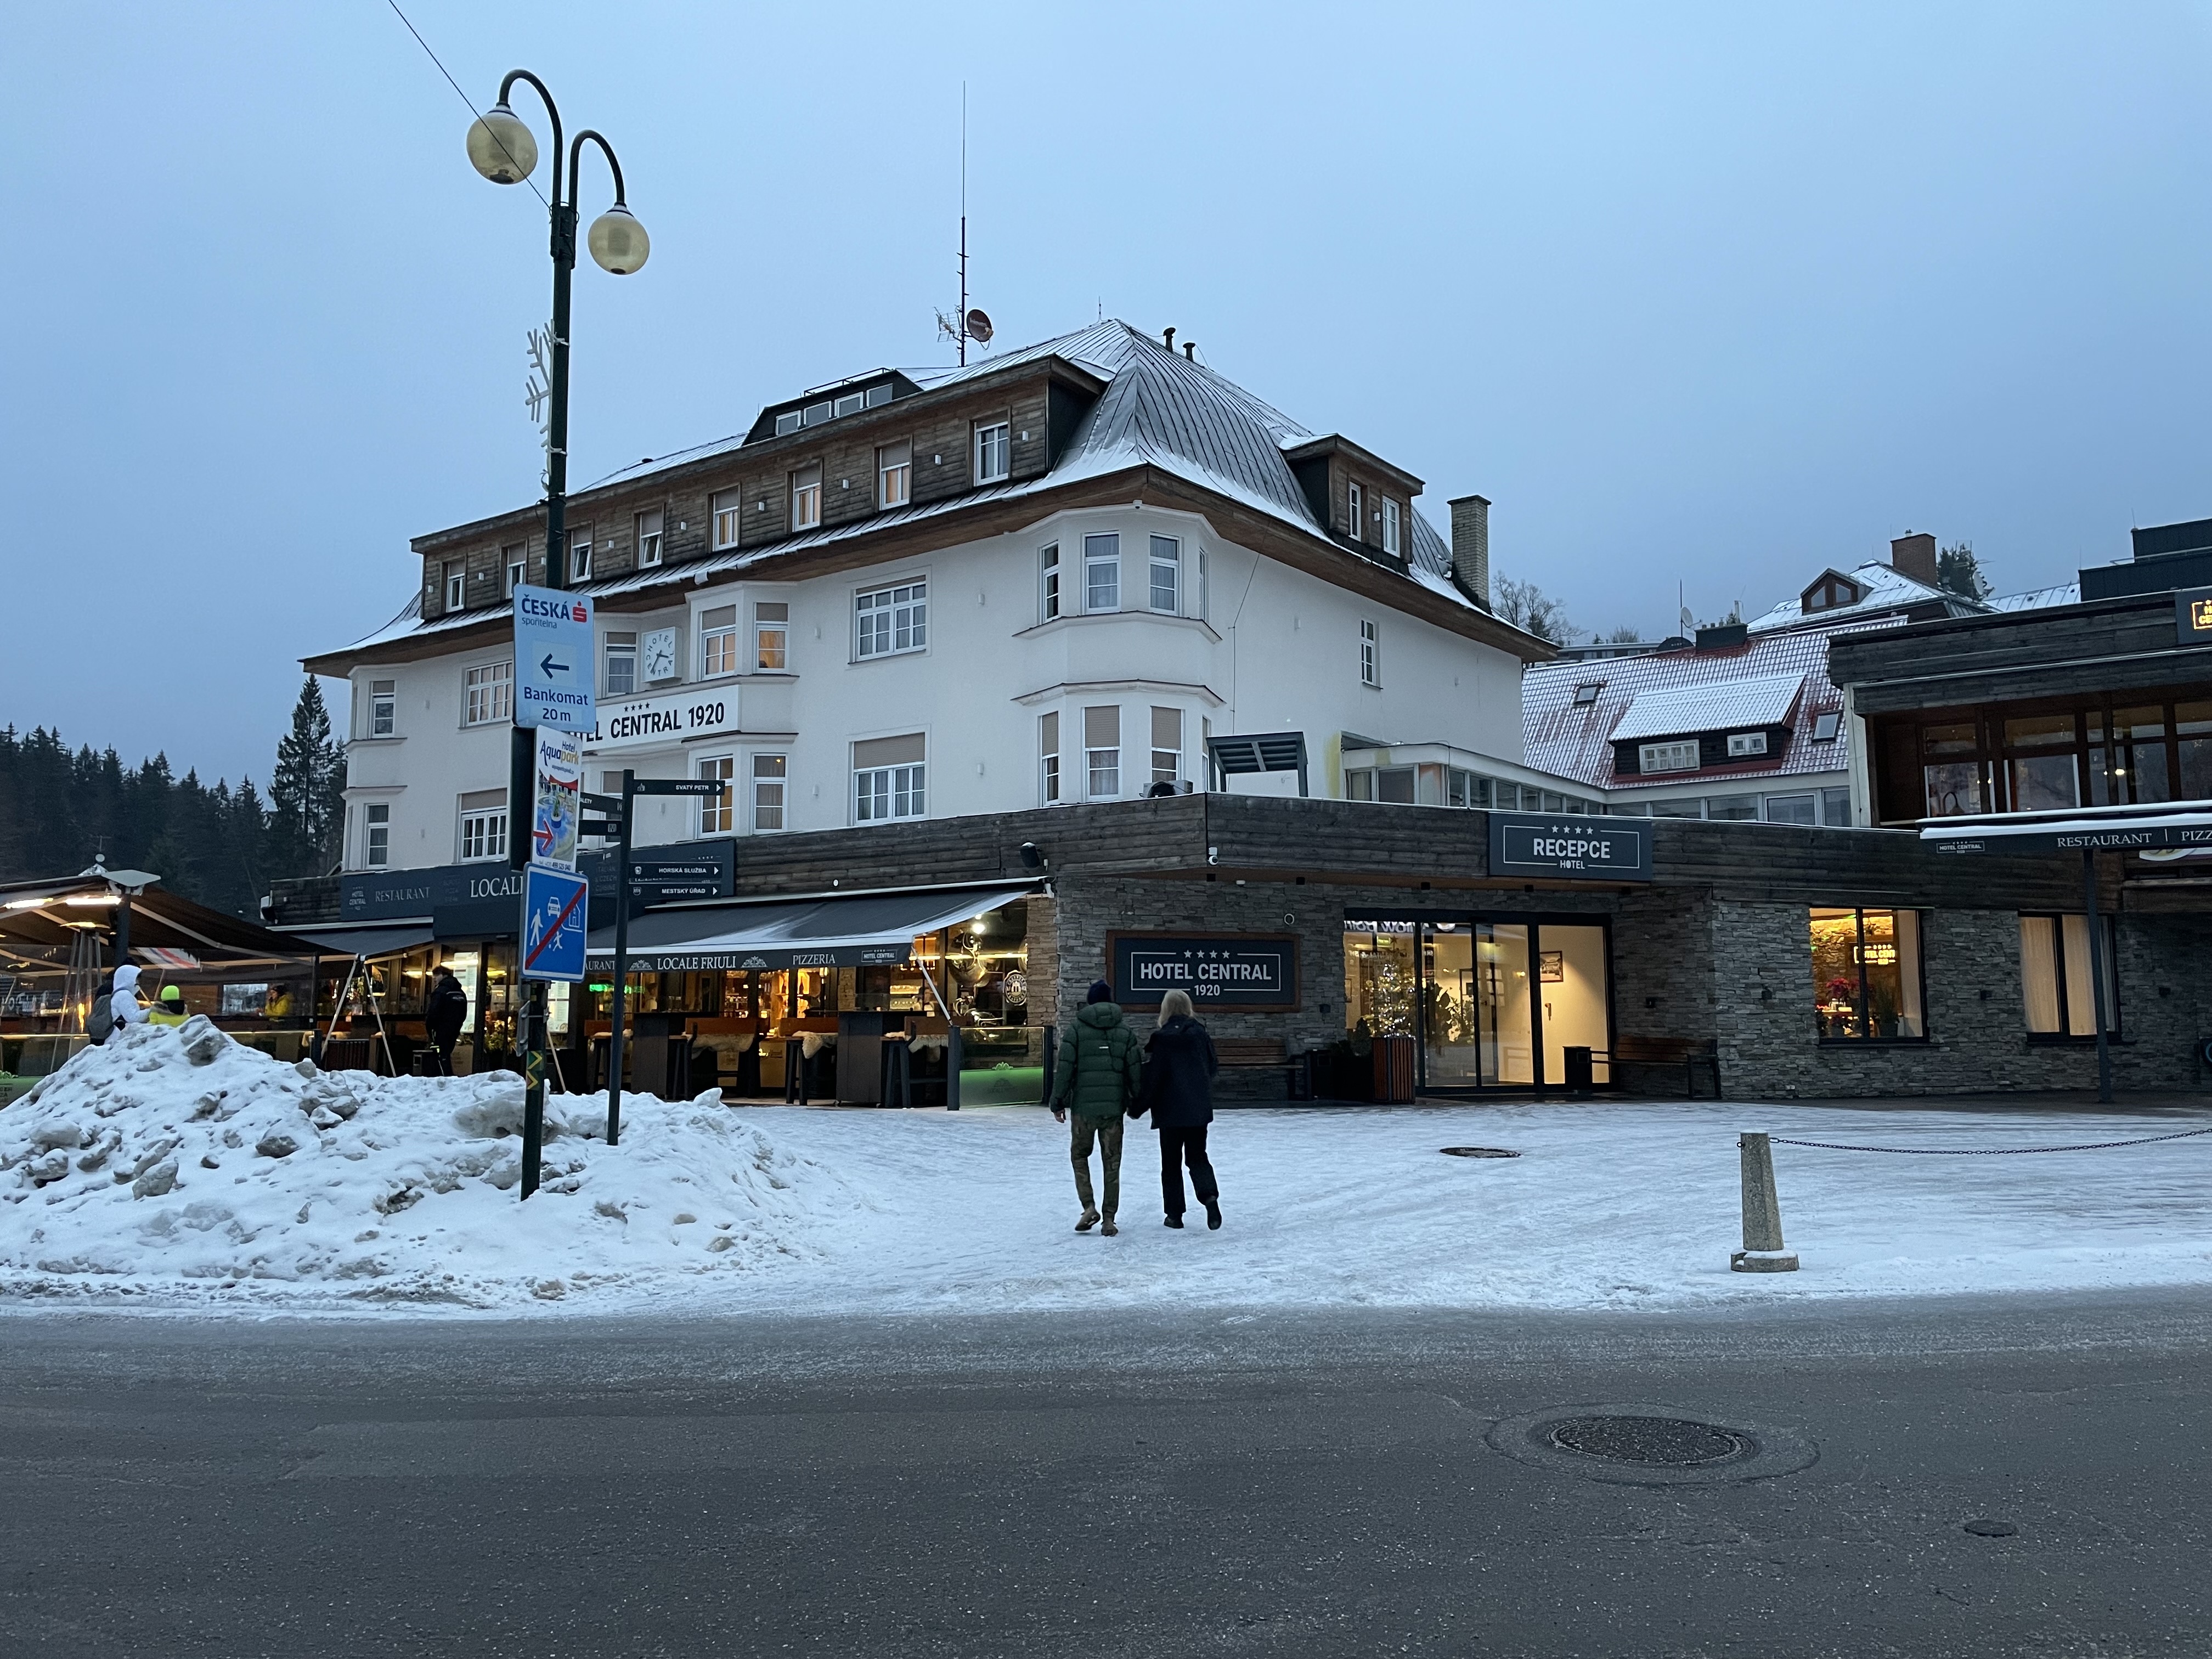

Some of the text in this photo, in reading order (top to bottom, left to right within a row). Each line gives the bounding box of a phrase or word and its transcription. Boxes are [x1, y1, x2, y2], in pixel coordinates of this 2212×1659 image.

[521, 594, 570, 620] ČESKÁ
[522, 616, 557, 629] spořitelna
[524, 687, 588, 706] Bankomat
[543, 709, 571, 721] 20 m
[611, 709, 681, 738] CENTRAL
[688, 702, 724, 727] 1920
[540, 740, 579, 766] Aquapark
[562, 741, 576, 752] Hotel
[2057, 831, 2212, 848] RESTAURANT PIZZ
[1533, 838, 1610, 859] RECEPCE
[1560, 860, 1585, 869] HOTEL
[375, 887, 430, 902] RESTAURANT
[585, 954, 836, 970] AURANT LOCALE FRIULI PIZZERIA
[1141, 963, 1272, 980] HOTEL CENTRAL
[1194, 984, 1220, 996] 1920
